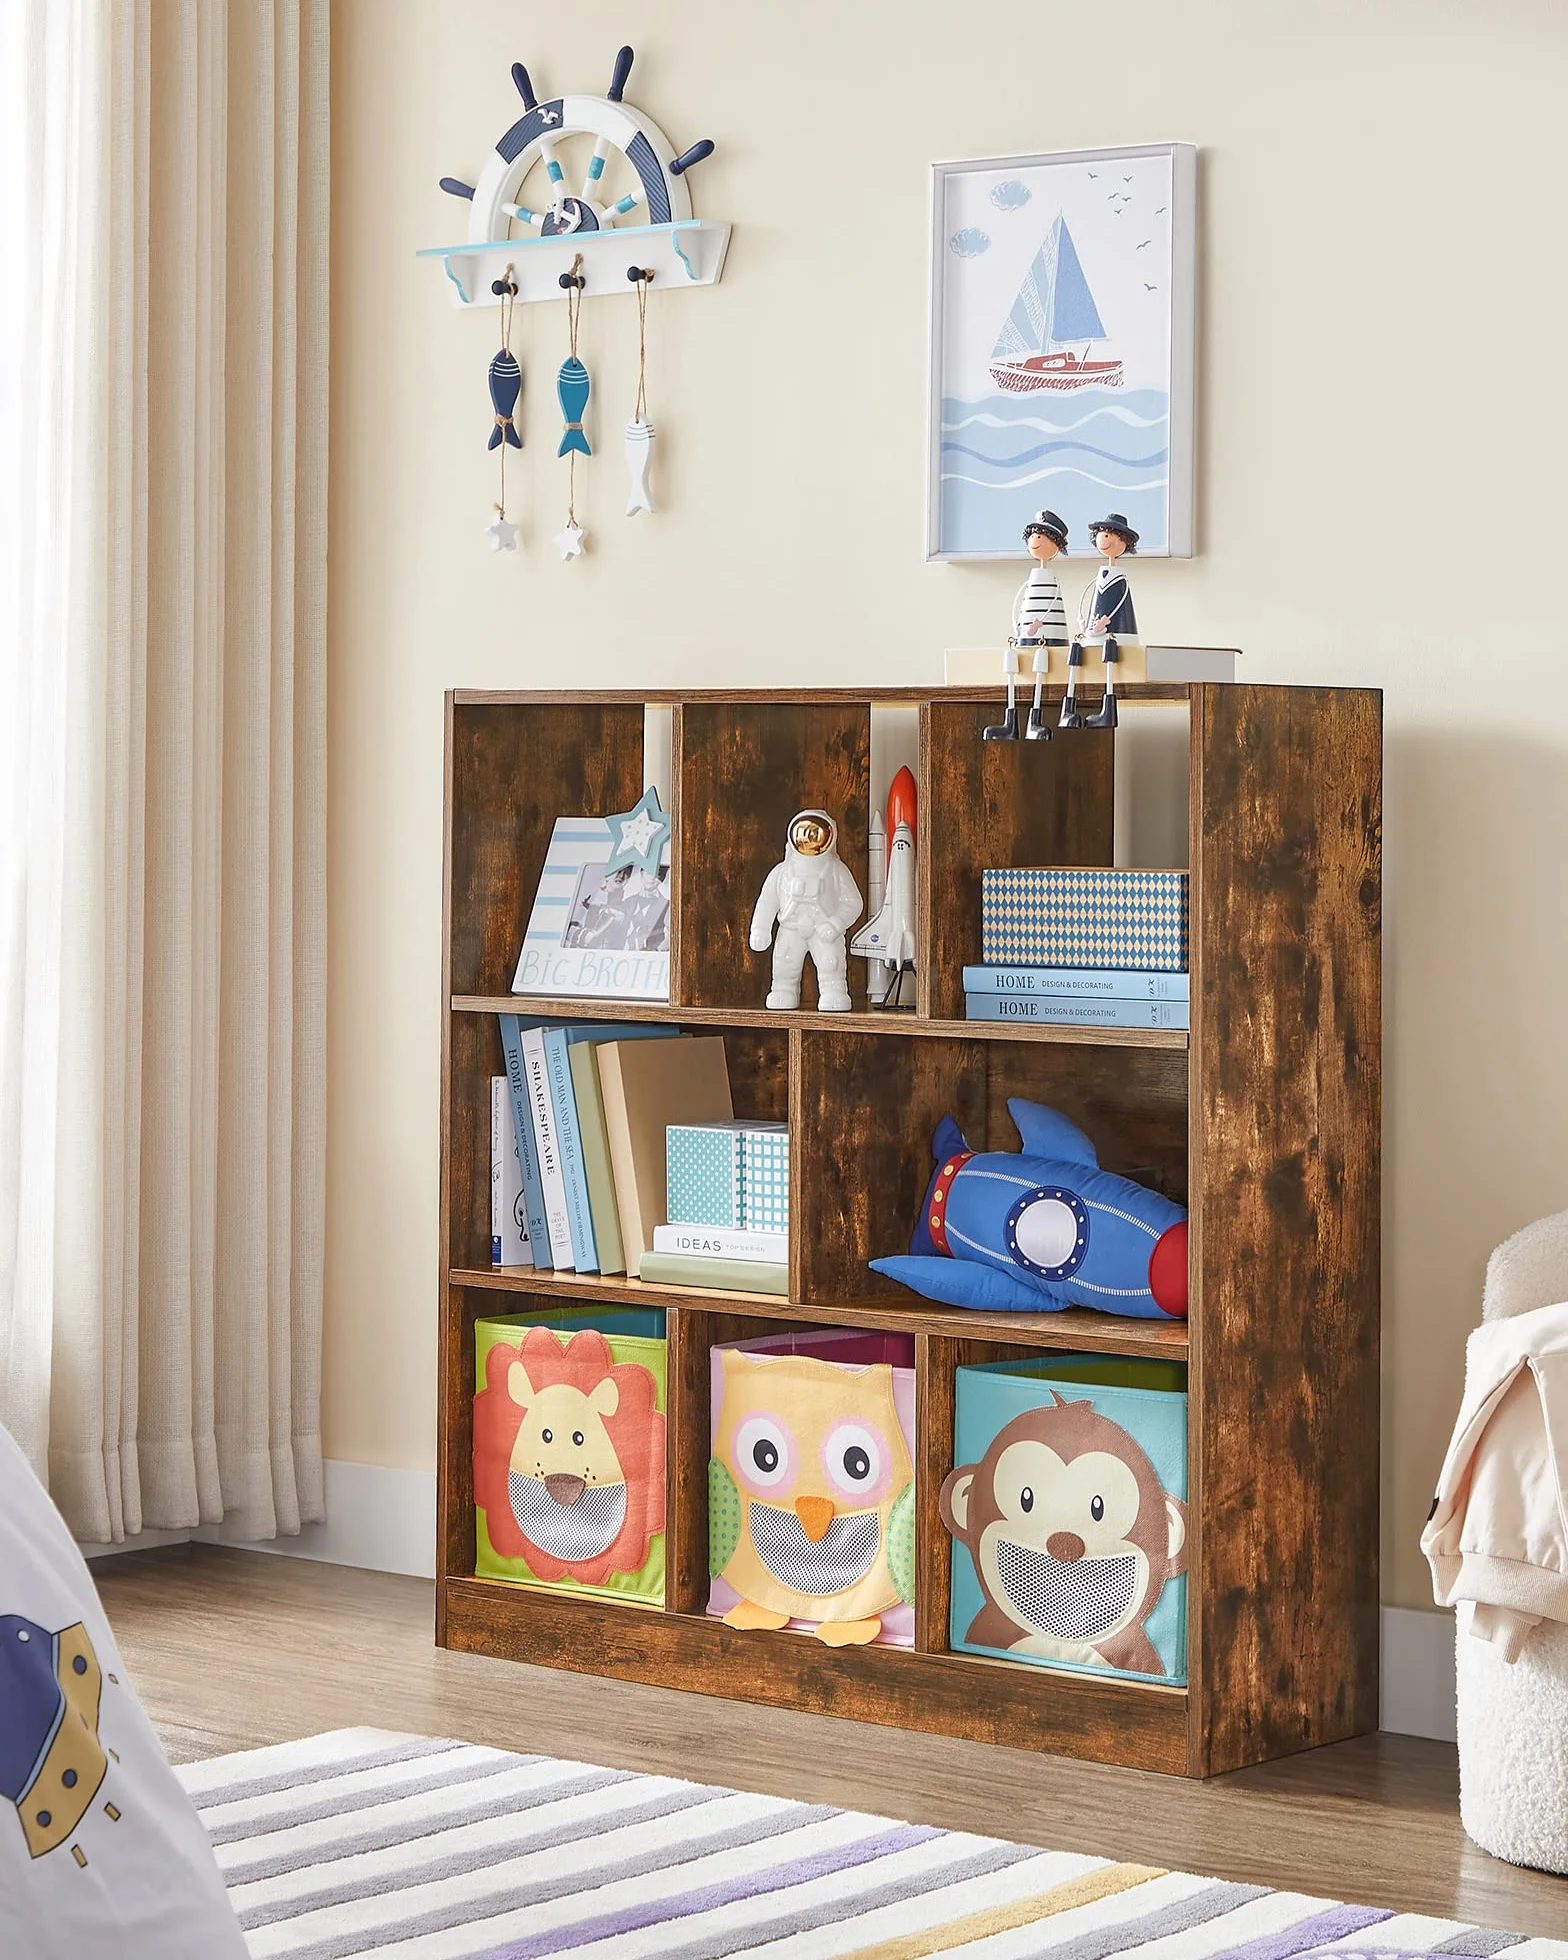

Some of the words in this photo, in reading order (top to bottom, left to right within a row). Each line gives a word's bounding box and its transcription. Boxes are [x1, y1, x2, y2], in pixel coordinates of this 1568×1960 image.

[996, 975, 1035, 989] HOME
[1042, 980, 1066, 988] DESIGN
[1072, 981, 1114, 990] DECORATING
[999, 1002, 1038, 1016] HOME
[1075, 1009, 1116, 1018] DECORATING
[551, 1046, 562, 1065] THE
[554, 1065, 564, 1084] OLD
[557, 1084, 568, 1105] MAN
[508, 1048, 523, 1094] HOME
[516, 1100, 526, 1127] DESIGN
[521, 1134, 533, 1181] DECORATING
[532, 1061, 555, 1176] SHAKESPEARE
[560, 1107, 570, 1126] AND
[563, 1126, 573, 1144] THE
[565, 1144, 575, 1161] SEA
[676, 1237, 722, 1252] IDEAS
